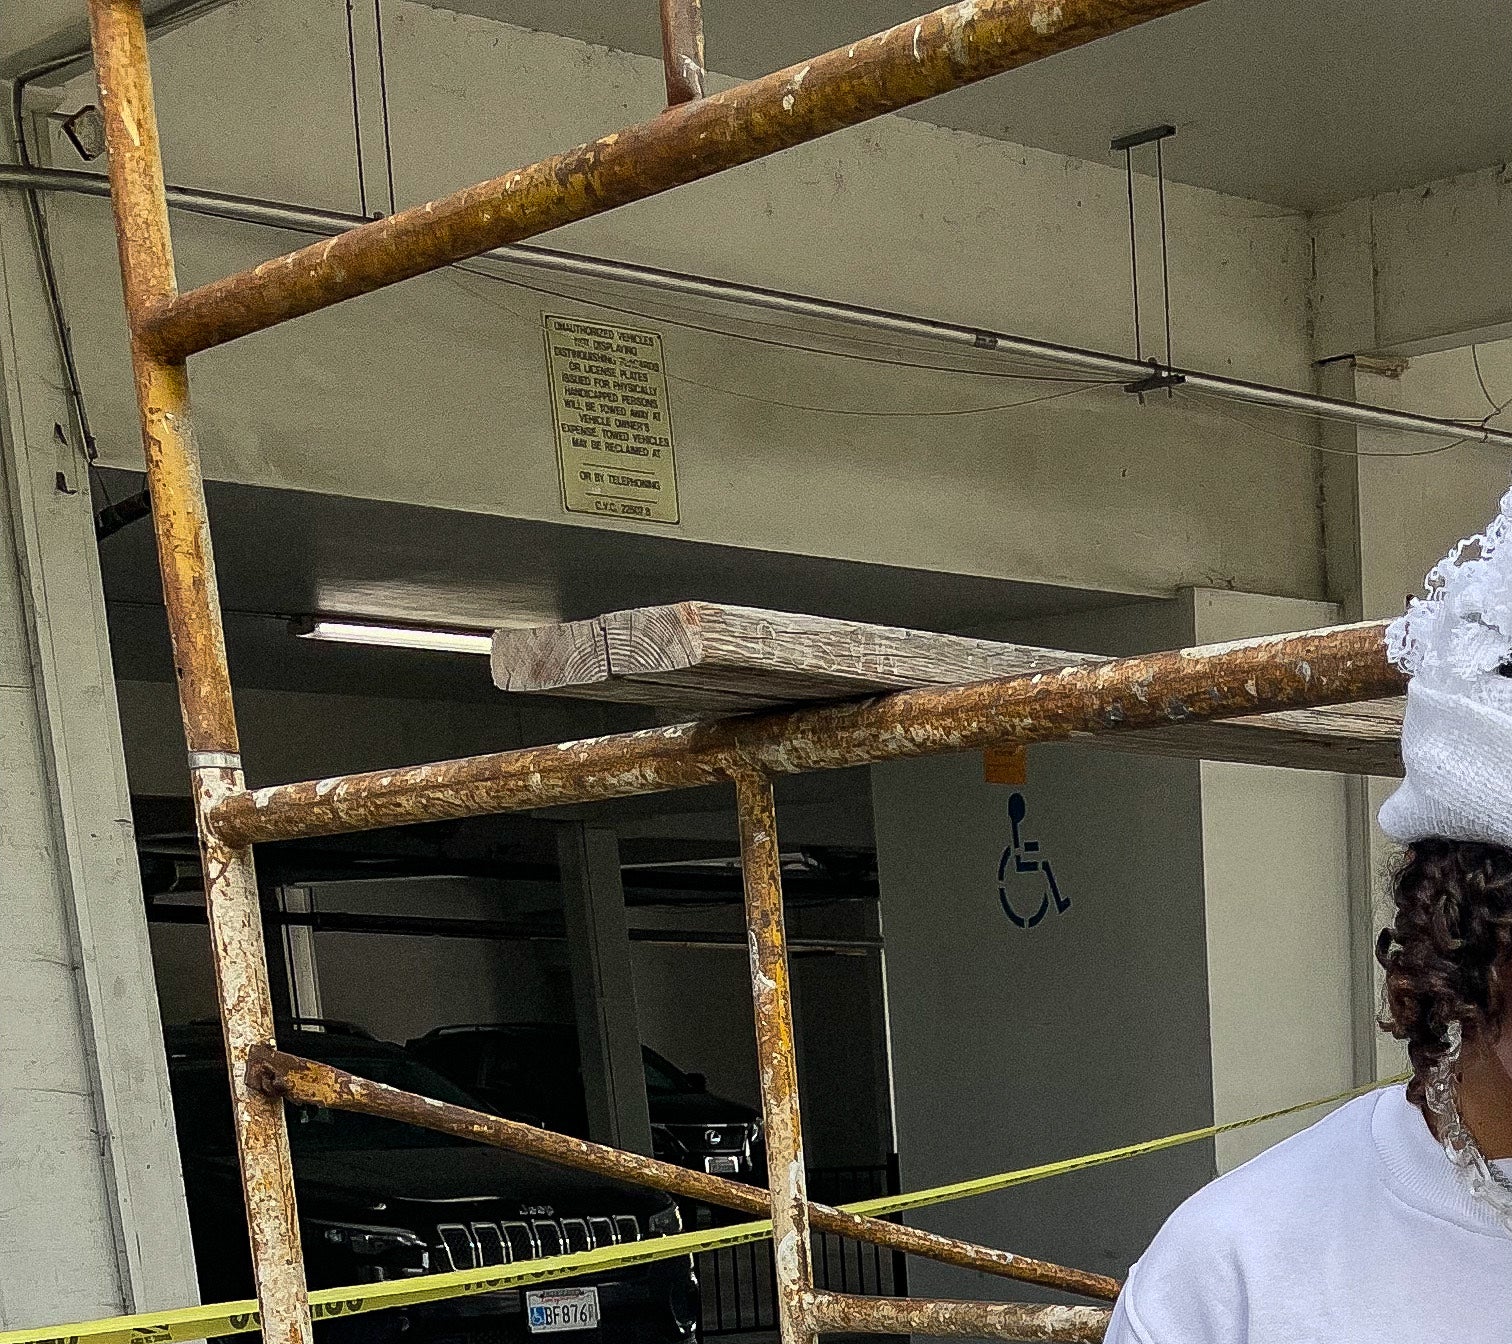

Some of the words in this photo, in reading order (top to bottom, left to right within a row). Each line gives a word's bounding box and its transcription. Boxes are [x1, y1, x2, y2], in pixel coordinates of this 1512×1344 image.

[562, 372, 591, 386] ISSUED
[593, 377, 610, 388] FOR
[584, 363, 617, 377] LICENSE
[620, 369, 648, 382] PLATES
[585, 401, 596, 412] BE
[600, 403, 626, 416] TOWED
[579, 413, 611, 427] VEHICLE
[601, 428, 629, 442] TOWED
[632, 433, 670, 447] VEHICLES
[591, 440, 601, 450] BE
[605, 441, 649, 457] RECLAIMED
[579, 470, 591, 482] OR
[594, 472, 604, 482] BY
[608, 473, 660, 490] TELEPHONING
